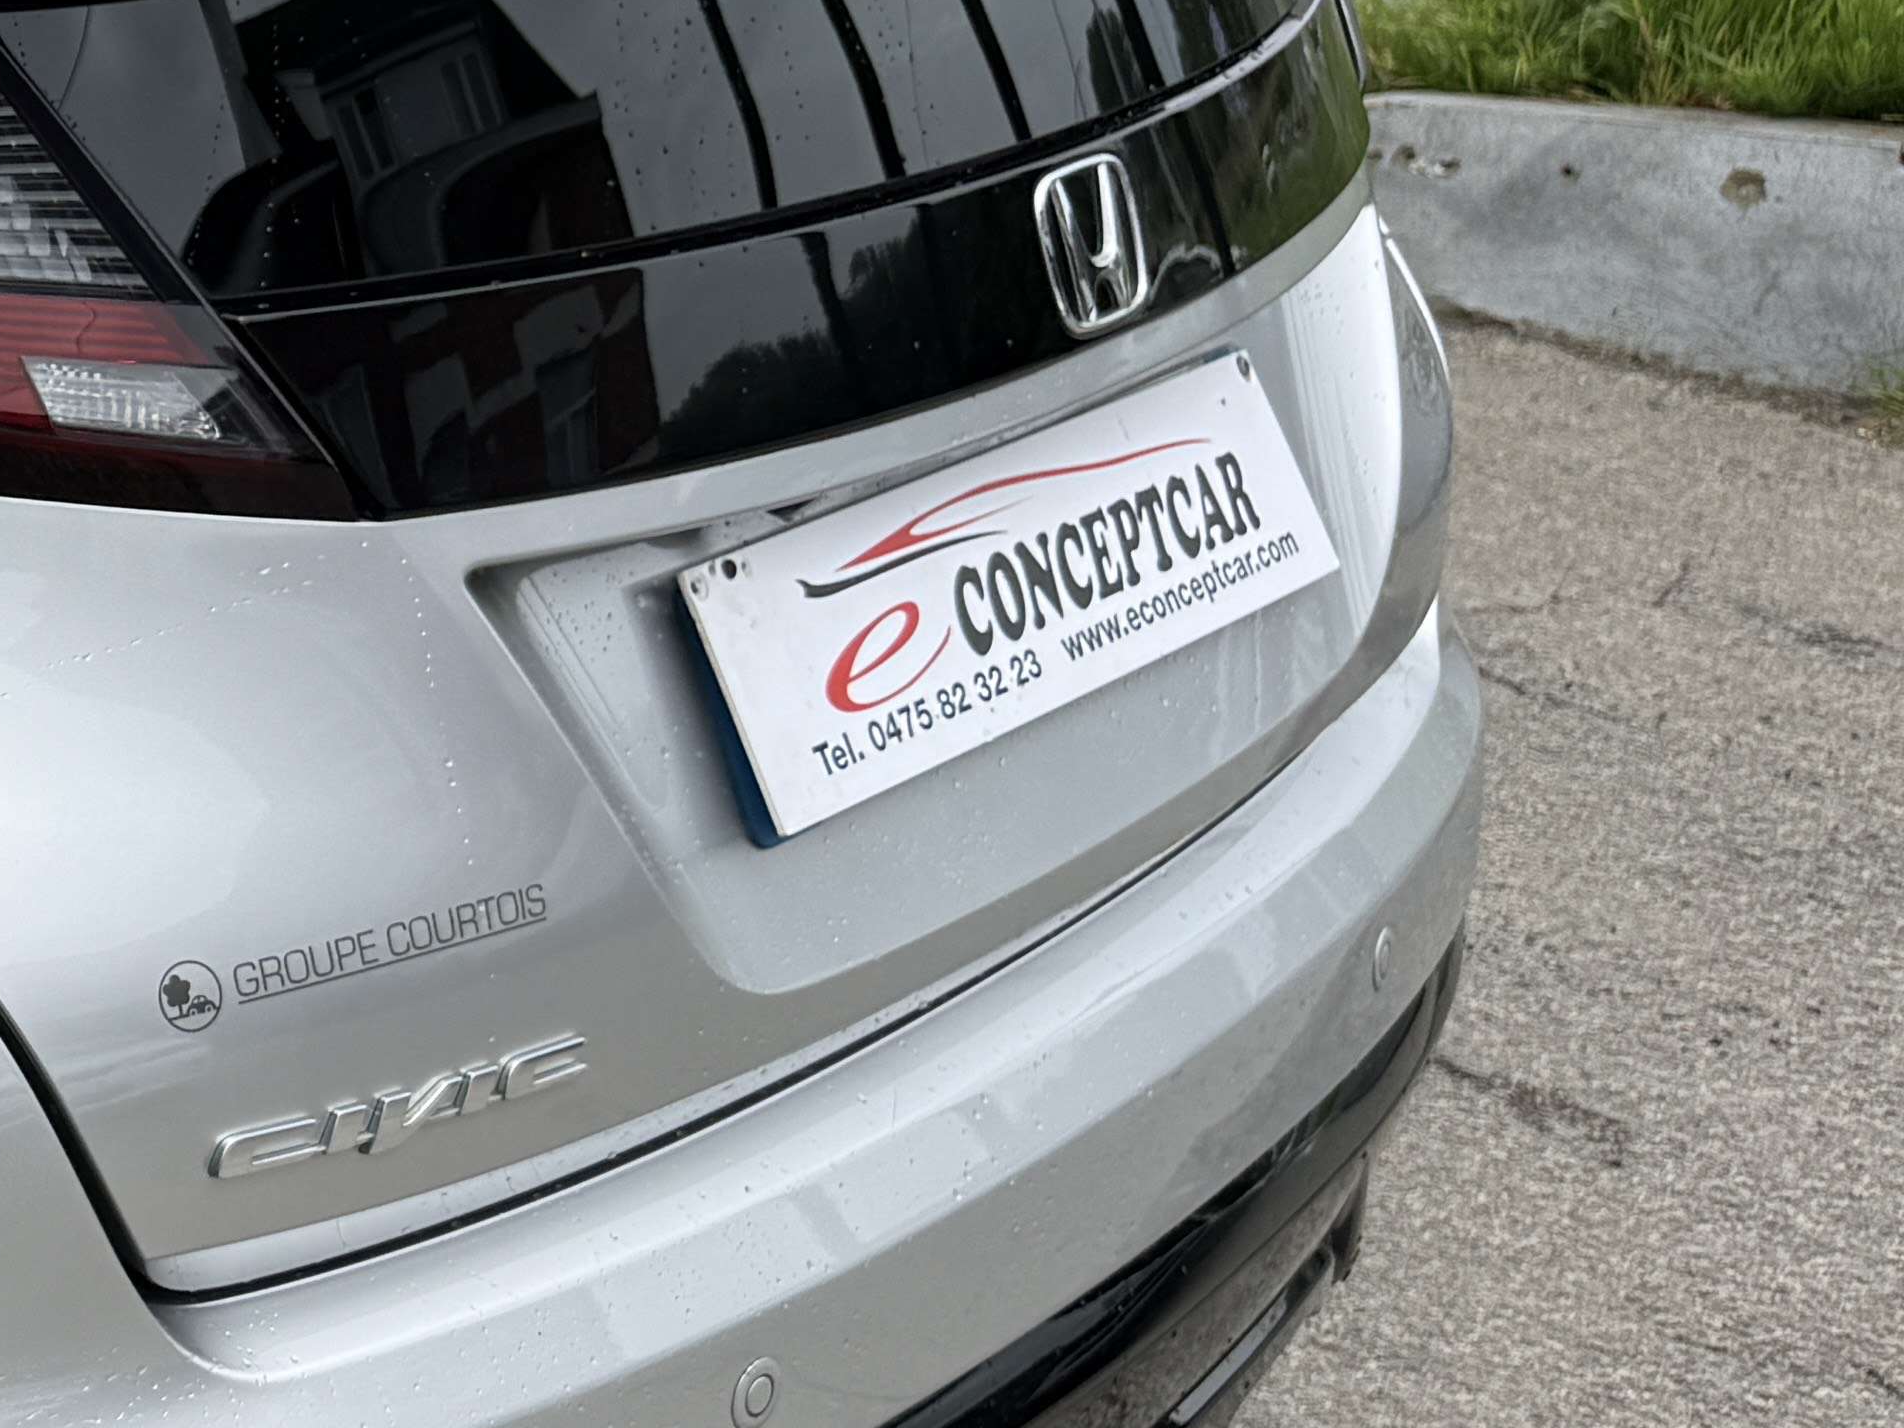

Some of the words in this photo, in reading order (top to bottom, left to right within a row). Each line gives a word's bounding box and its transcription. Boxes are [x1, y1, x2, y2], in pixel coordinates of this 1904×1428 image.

[953, 451, 1261, 657] CONCEPTCAR
[812, 732, 866, 776] Tel.
[867, 697, 934, 753] 0475
[936, 681, 973, 721] 82
[974, 664, 1009, 703] 32
[1009, 648, 1043, 688] 23
[1060, 530, 1300, 662] www.econceptcar.com
[232, 929, 380, 999] GROUPE
[385, 883, 547, 958] COURTOIS
[206, 1032, 588, 1180] CIVIC
